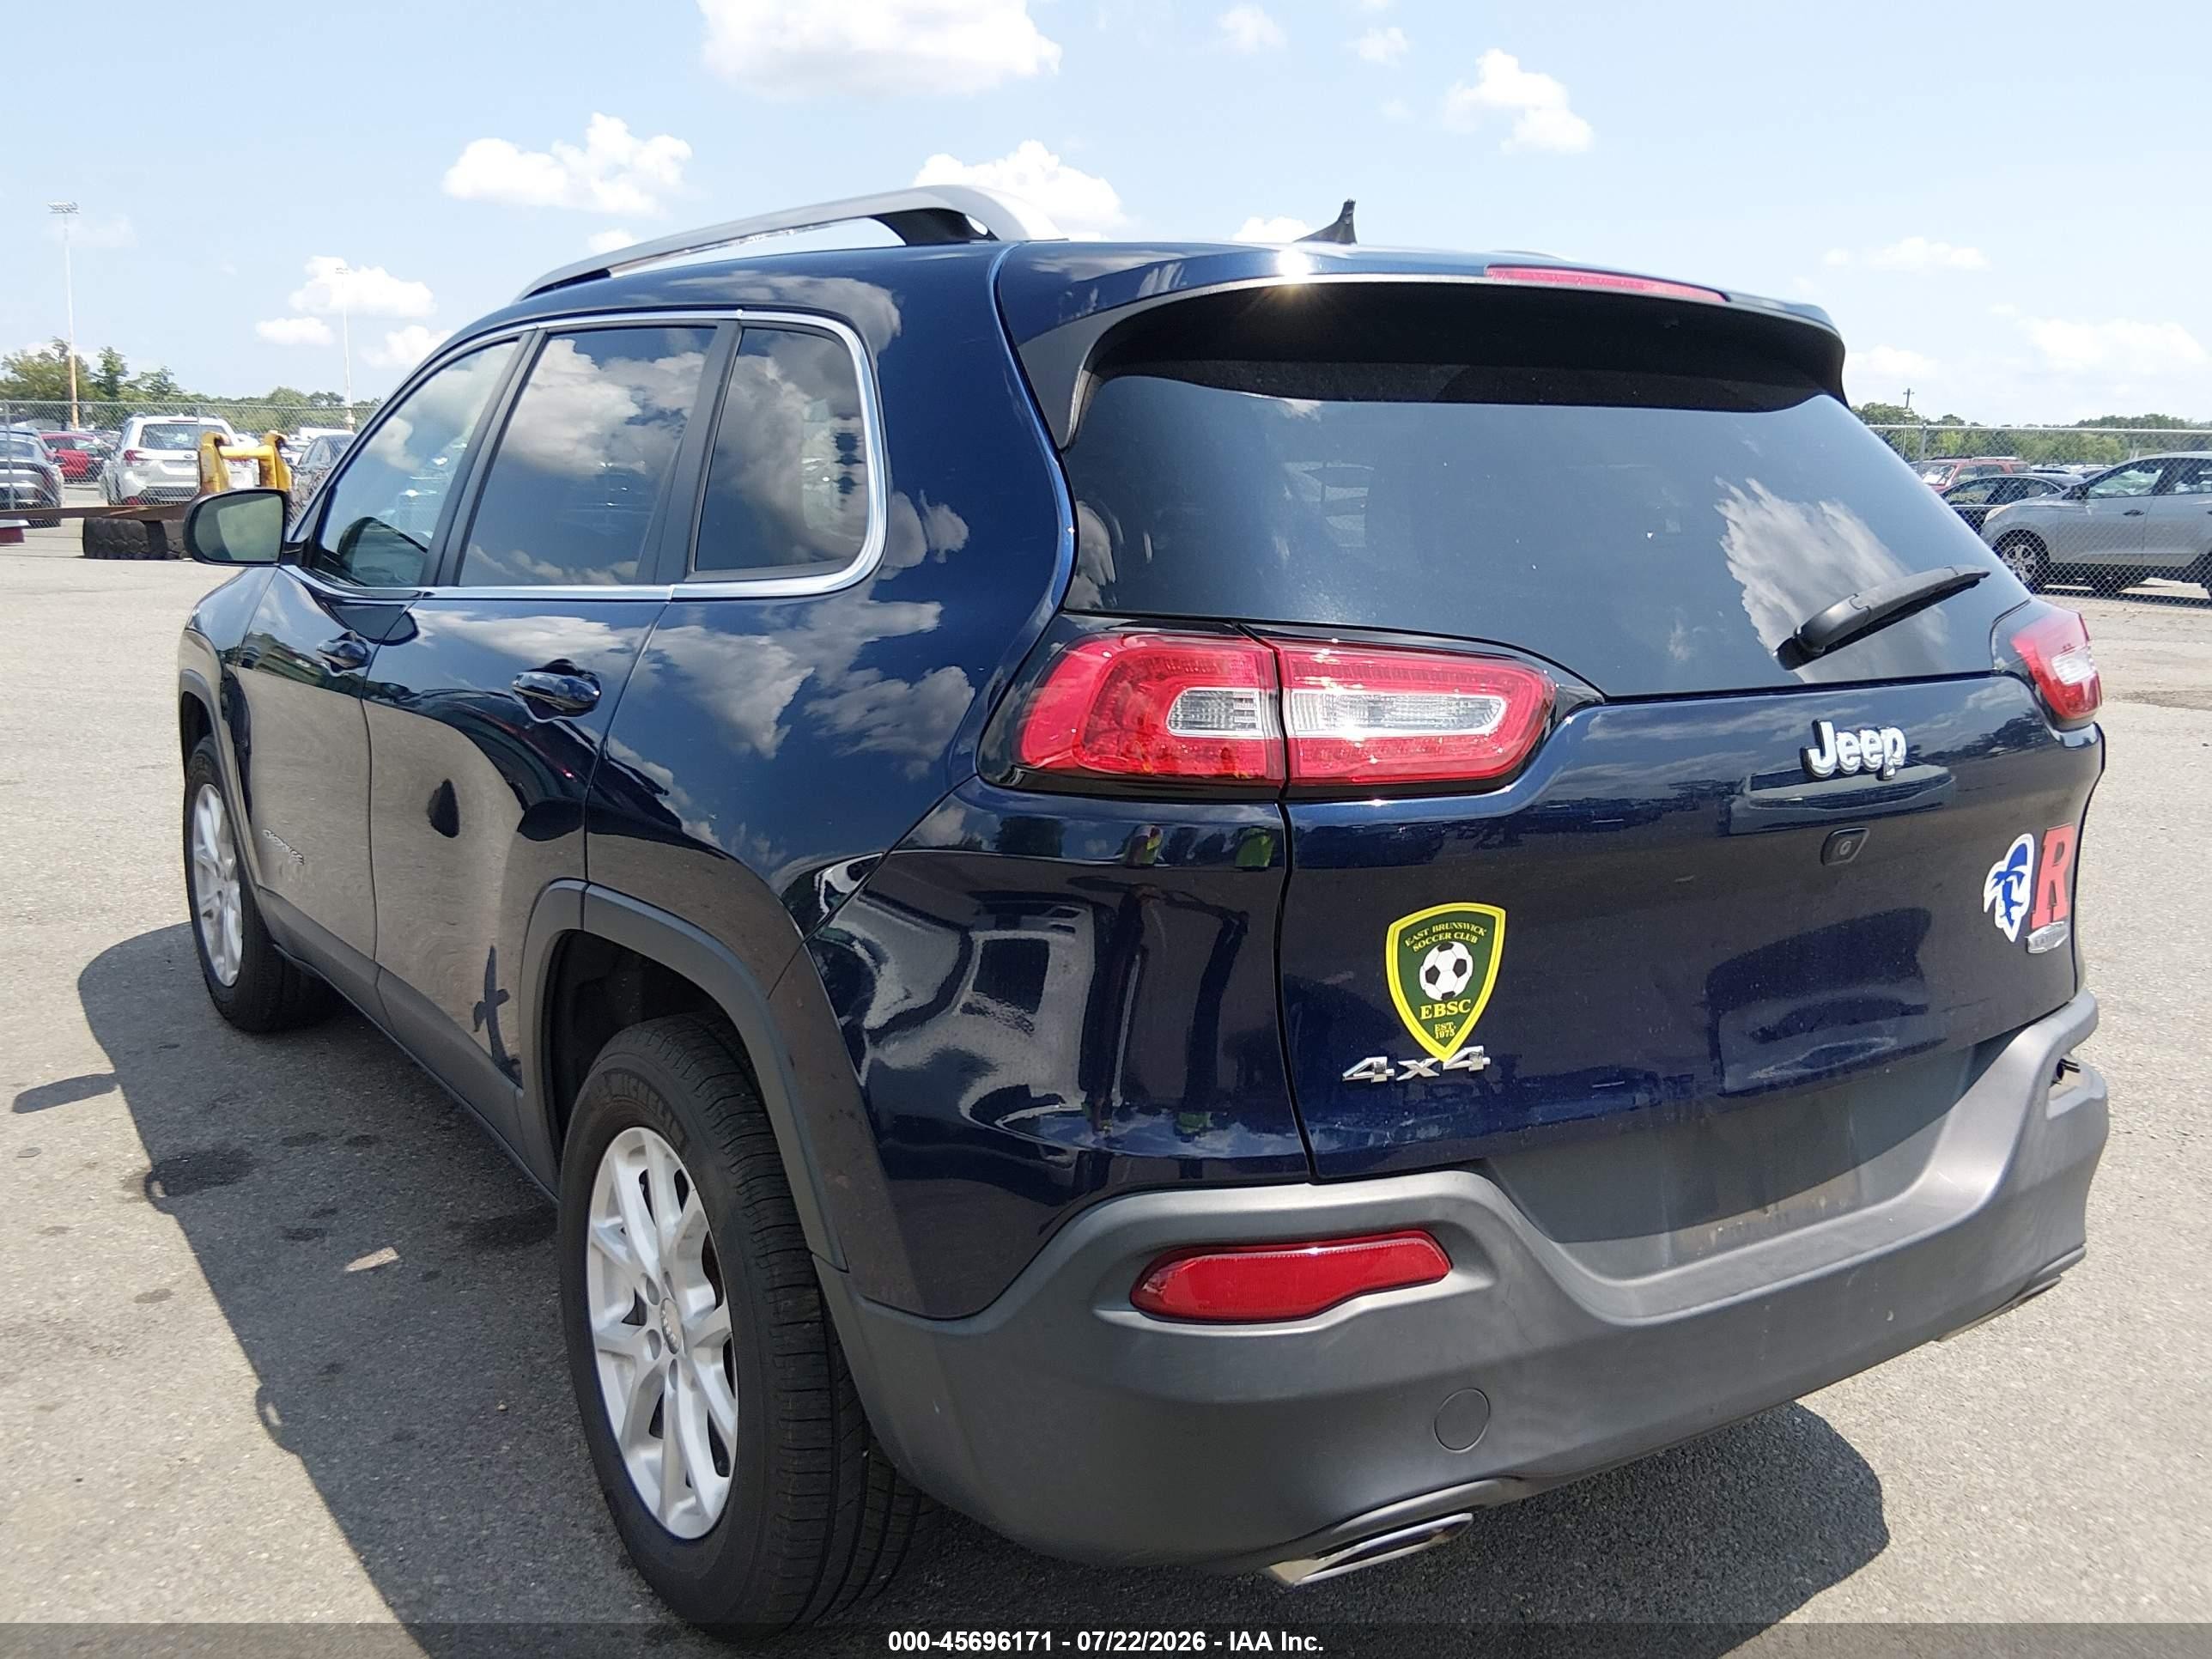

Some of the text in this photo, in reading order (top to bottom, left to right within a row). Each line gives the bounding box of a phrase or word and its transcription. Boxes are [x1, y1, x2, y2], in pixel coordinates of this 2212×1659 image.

[1801, 720, 1907, 781] Jeep
[2030, 823, 2075, 930] R
[1405, 921, 1487, 947] EAST BRUNSWICK
[1413, 932, 1478, 952] SOCCER CLUB
[1419, 999, 1471, 1020] EBSC
